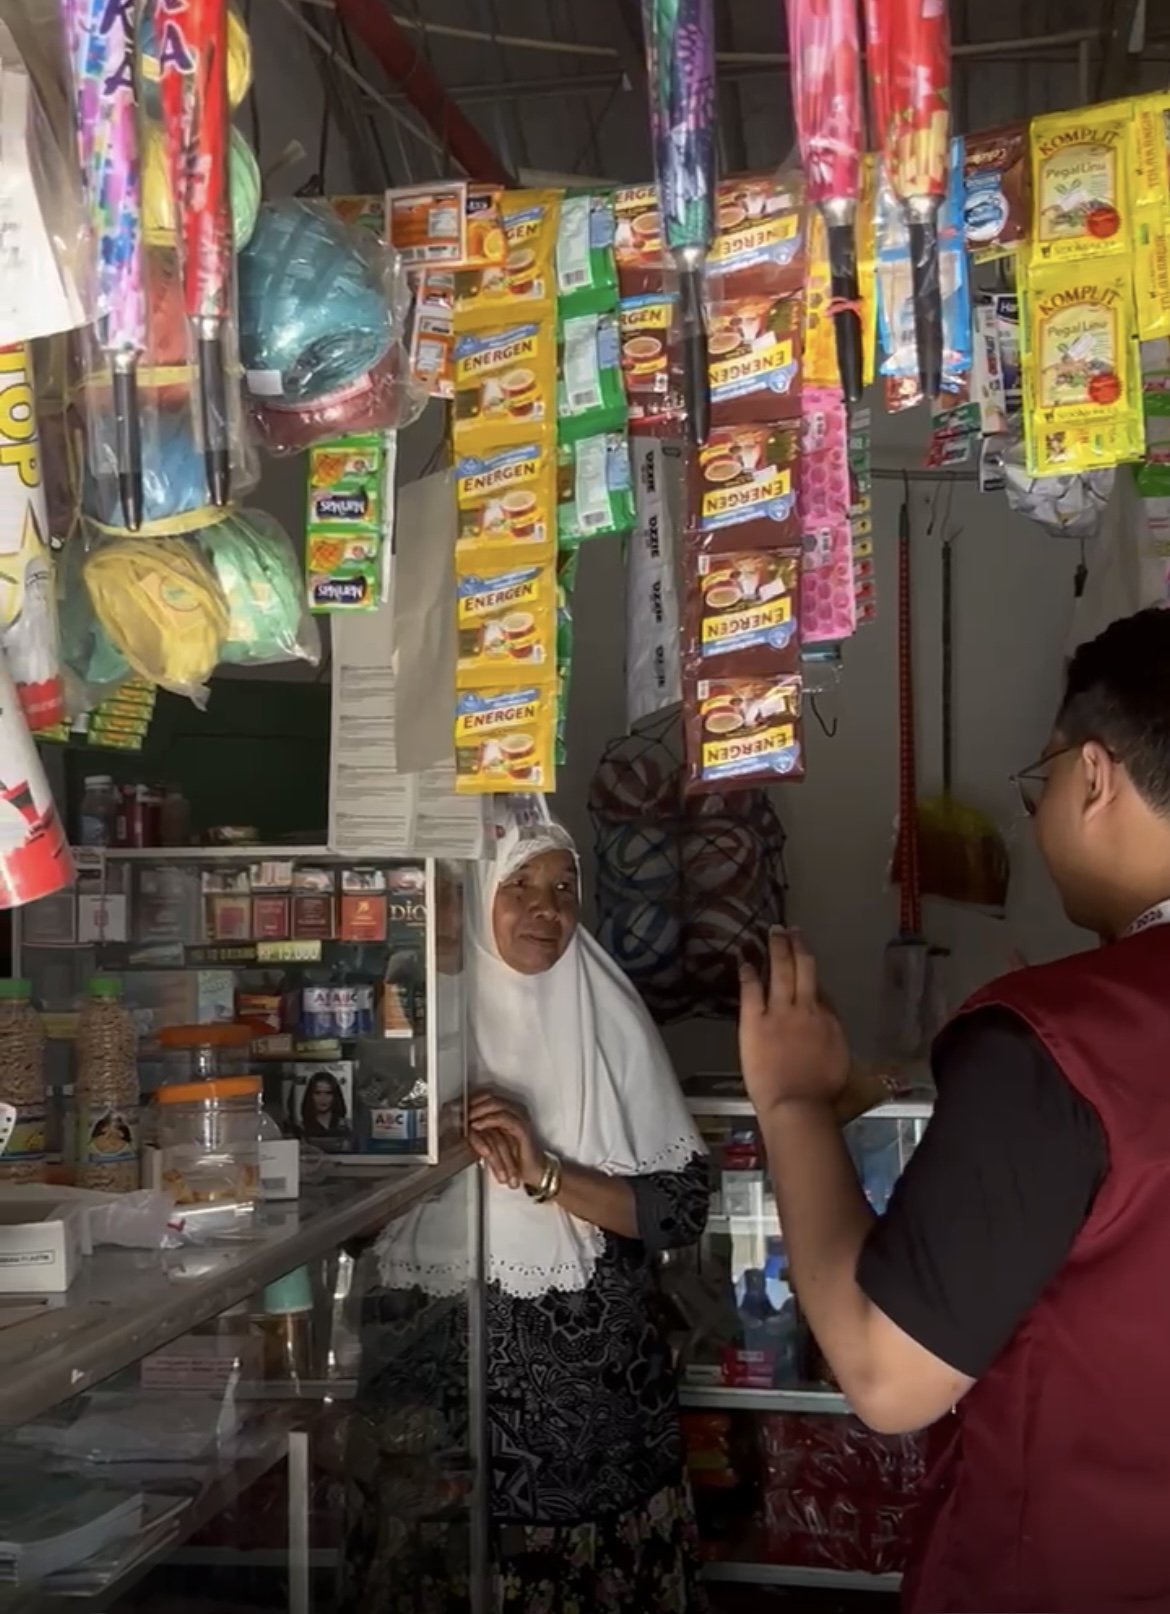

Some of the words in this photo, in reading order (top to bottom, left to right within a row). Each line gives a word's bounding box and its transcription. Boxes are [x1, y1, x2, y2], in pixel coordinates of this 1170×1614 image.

[1038, 127, 1120, 157] KOMPLIT
[1038, 285, 1121, 316] KOMPLIT
[463, 341, 534, 371] ENERGEN
[463, 462, 537, 493] ENERGEN
[707, 479, 784, 512] ENERGEN
[463, 582, 533, 613] ENERGEN
[707, 607, 784, 638] ENERGEN
[463, 703, 537, 730] ENERGEN
[707, 735, 788, 763] ENERGEN
